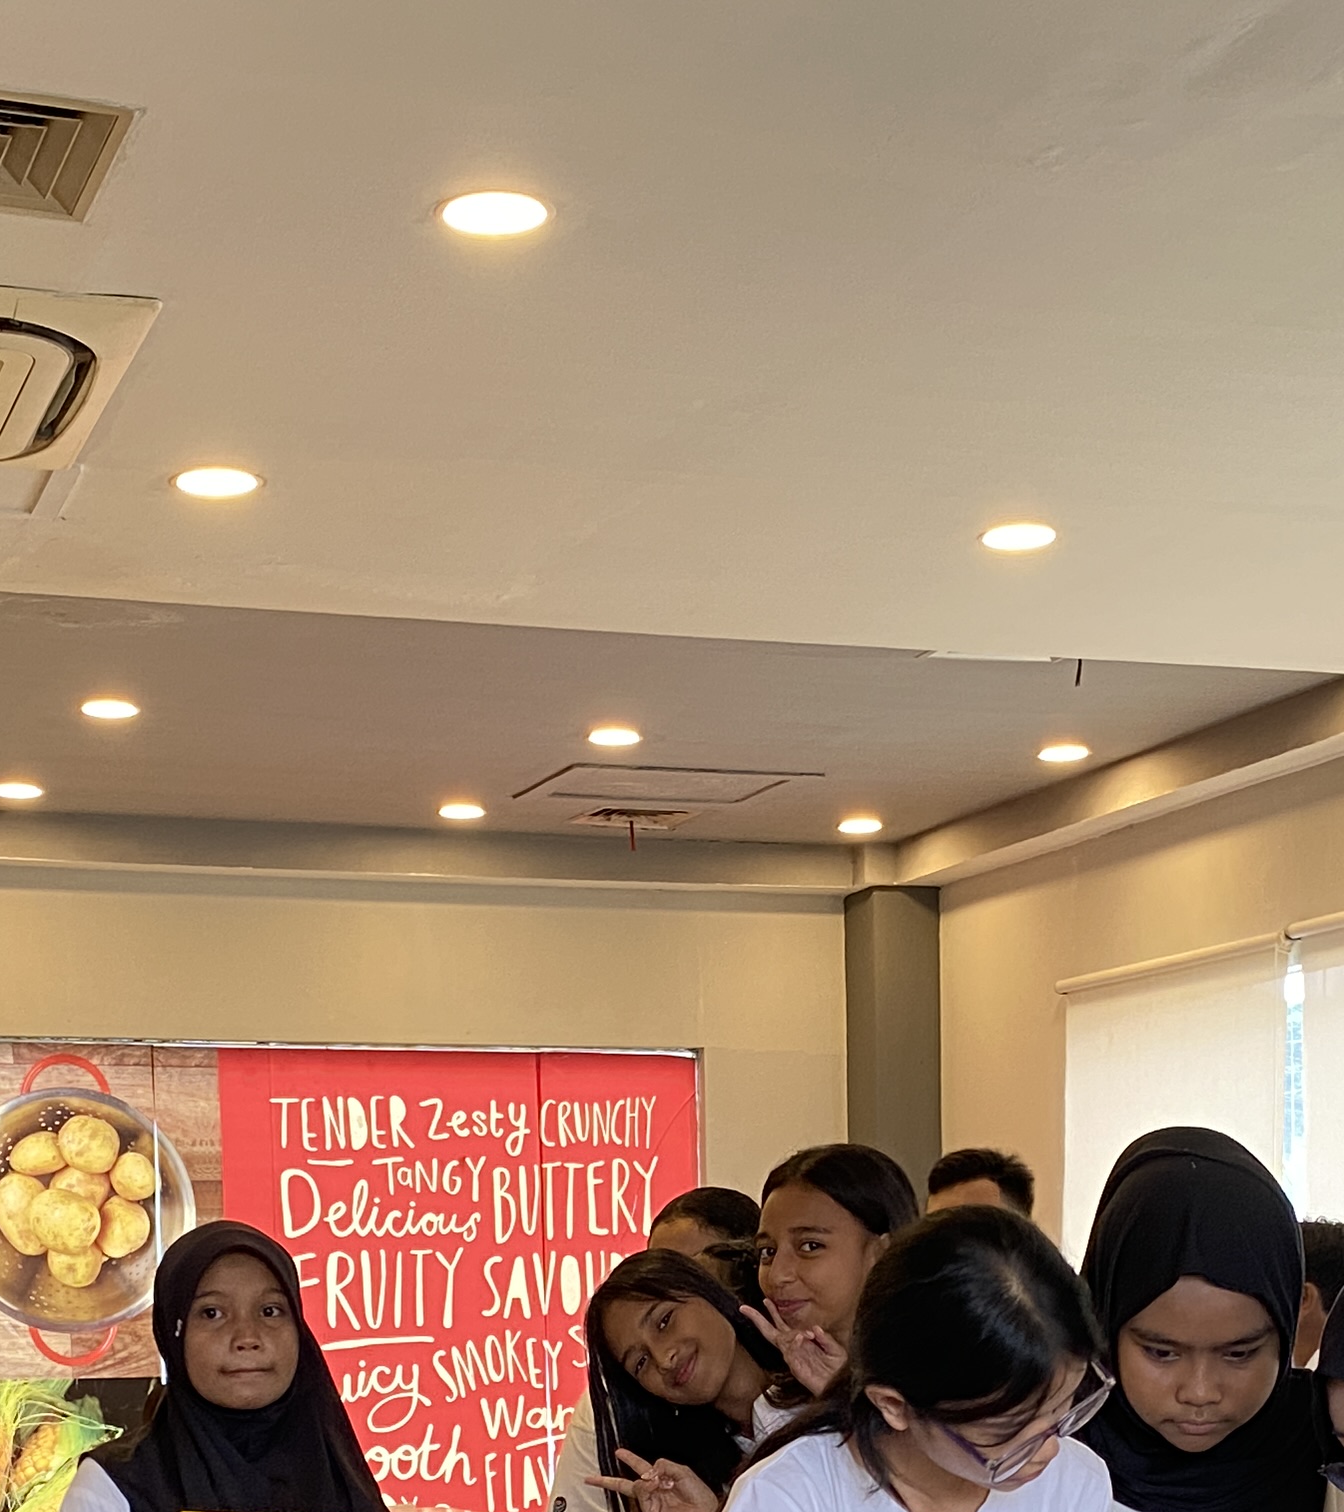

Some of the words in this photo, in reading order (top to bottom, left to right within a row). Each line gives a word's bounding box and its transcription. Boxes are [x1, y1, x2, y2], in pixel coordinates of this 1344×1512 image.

[268, 1094, 415, 1152] TENDER
[418, 1097, 531, 1157] Zesty
[539, 1094, 657, 1150] CRUNCHY
[279, 1168, 482, 1242] Delicious
[492, 1156, 659, 1245] BUTTERY
[340, 1359, 432, 1434] uicy
[432, 1328, 564, 1404] SMOKEY
[479, 1394, 576, 1440] War
[364, 1424, 478, 1486] ooth
